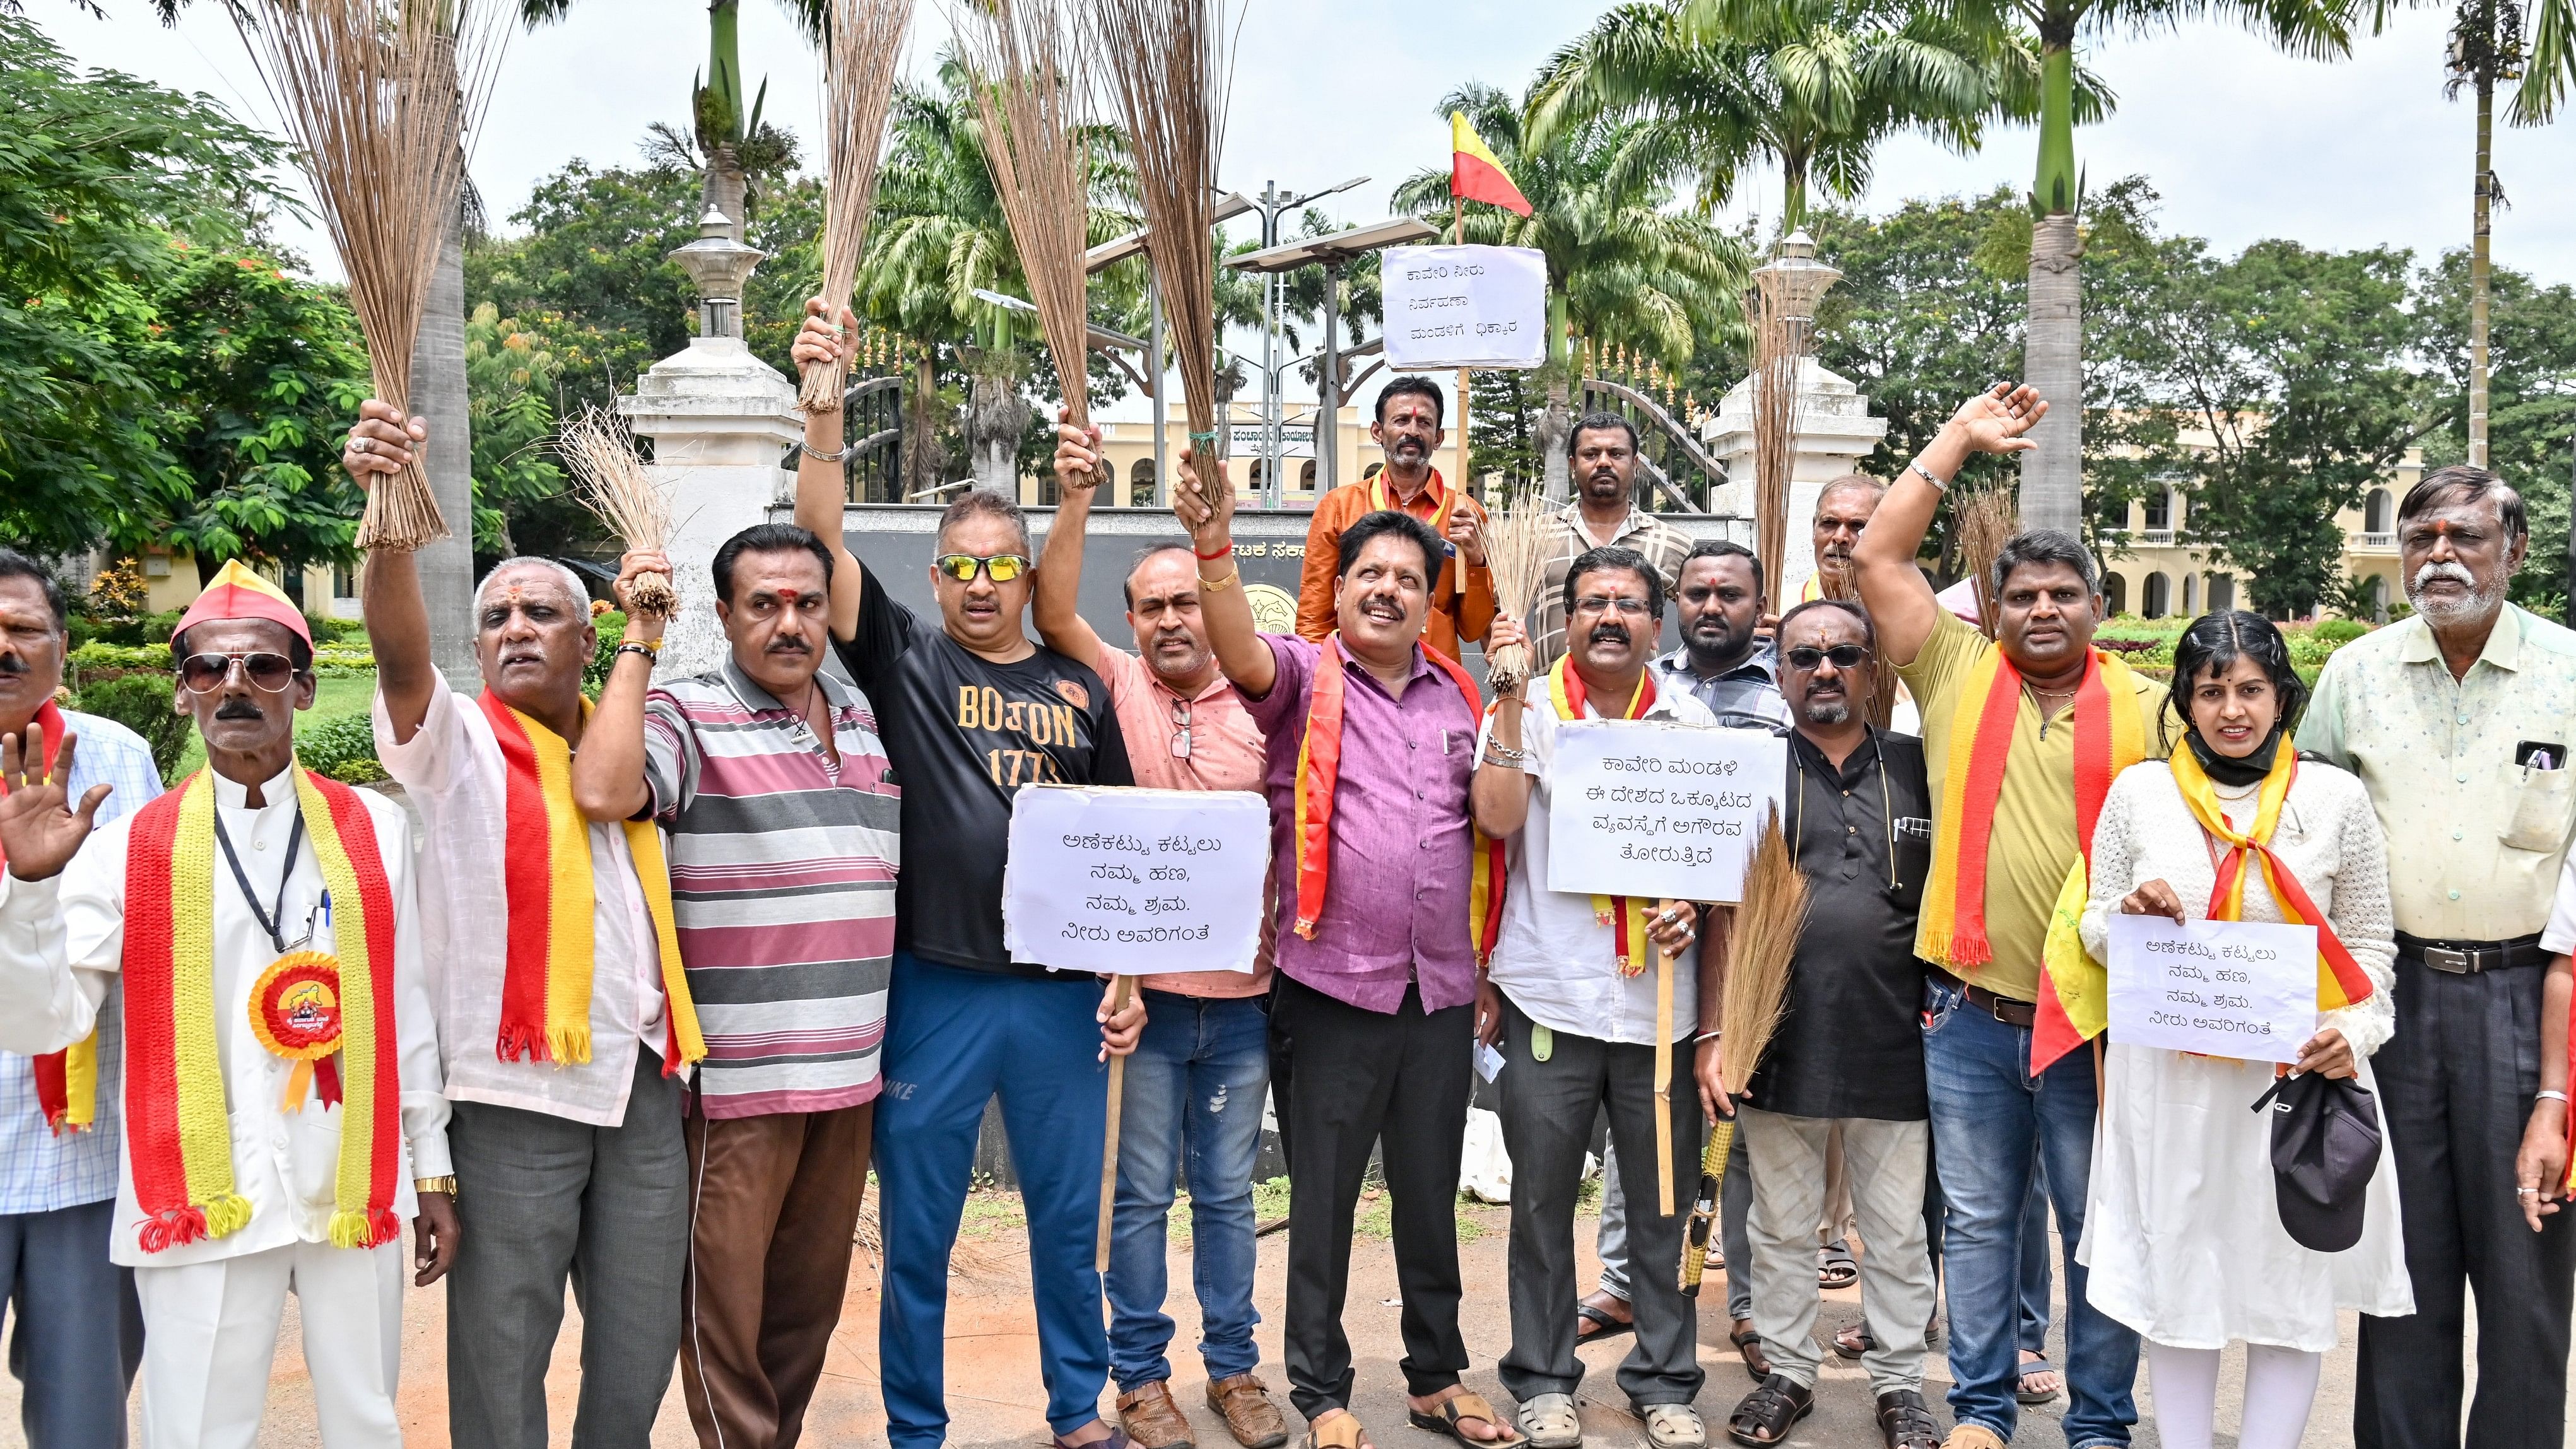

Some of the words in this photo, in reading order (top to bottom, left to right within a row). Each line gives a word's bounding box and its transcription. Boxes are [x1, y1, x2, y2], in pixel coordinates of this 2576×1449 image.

[1406, 266, 1448, 281] ಕಾವೇರಿ
[1454, 263, 1485, 278] ನೀರು
[1409, 295, 1469, 311] ನಿರ್ವಹಣಾ
[1410, 323, 1464, 339] ಮಂಡಳಿಗೆ
[1476, 319, 1517, 337] ಧಿಕ್ಕಾರ
[1602, 755, 1662, 773] ಕಾವೇರಿ
[1668, 758, 1738, 777] ಮಂಡಳಿ
[1585, 785, 1605, 801] ಈ
[1611, 785, 1665, 804] ದೇಶದ
[1671, 790, 1752, 811] ಒಕ್ಕೂಟದ
[1592, 813, 1667, 836] ವ್ಯವಸ್ಥೆಗೆ
[1673, 818, 1742, 836] ಅಗೌರವ
[1062, 833, 1150, 856] ಅಣೆಕಟ್ಟು
[1157, 835, 1221, 856] ಕಟ್ಟಲು
[1620, 843, 1712, 867] ತೋರುತ್ತಿದೆ
[1090, 862, 1142, 884] ನಮ್ಮ
[1149, 864, 1190, 883] ಹಣ,
[1086, 894, 1138, 915] ನಮ್ಮ
[1144, 895, 1190, 916] ಶ್ರಮ.
[1061, 922, 1110, 941] ನೀರು
[1117, 924, 1209, 943] ಅವರಿಗಂತೆ
[2146, 940, 2216, 960] ಅಣೆಕಟ್ಟು
[2221, 944, 2276, 963] ಕಟ್ಟಲು
[2168, 964, 2210, 983] ನಮ್ಮ
[2215, 968, 2251, 985] ಹಣ,
[2166, 988, 2208, 1007] ನಮ್ಮ
[2213, 993, 2252, 1009] ಶ್ರಮ.
[2149, 1010, 2187, 1027] ನೀರು
[2192, 1018, 2271, 1035] ಅವರಿಗಂತೆ
